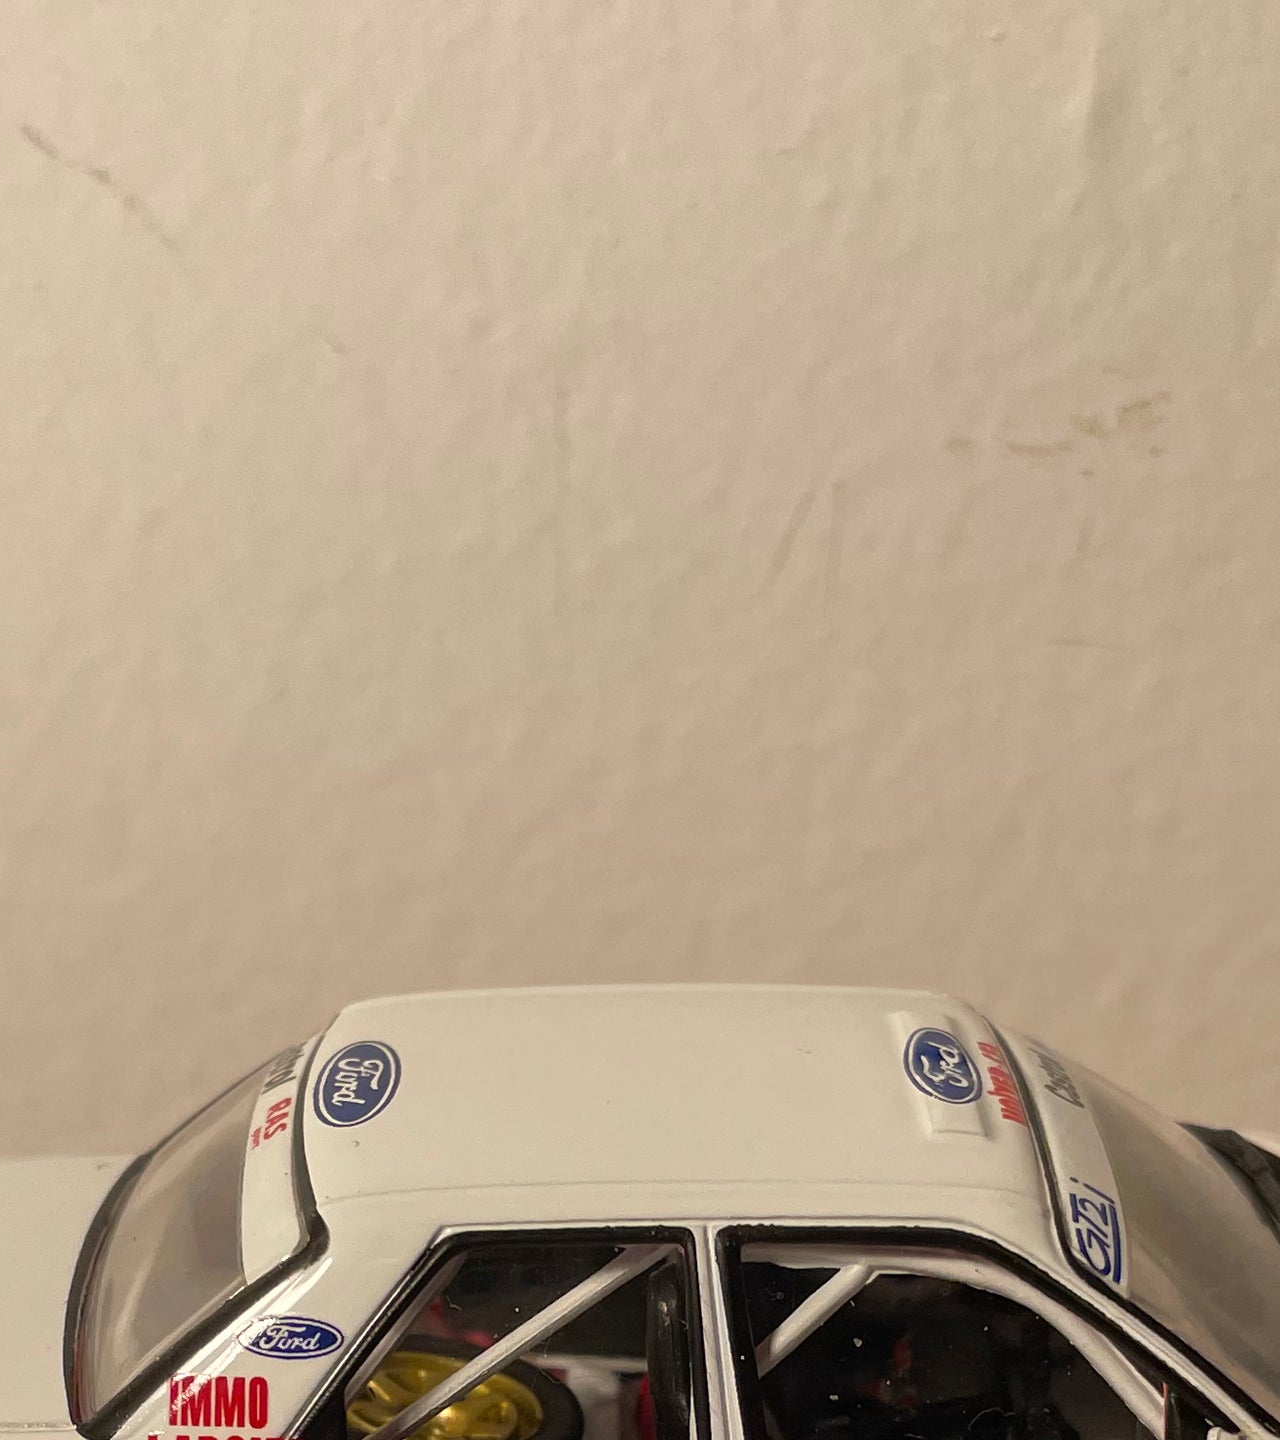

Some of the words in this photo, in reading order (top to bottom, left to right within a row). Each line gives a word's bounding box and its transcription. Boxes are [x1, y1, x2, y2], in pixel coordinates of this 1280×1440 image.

[331, 1057, 384, 1106] Ford
[920, 1041, 970, 1088] Ford
[263, 1097, 292, 1140] RAS
[258, 1325, 321, 1350] Ford
[168, 1375, 269, 1429] IMMO
